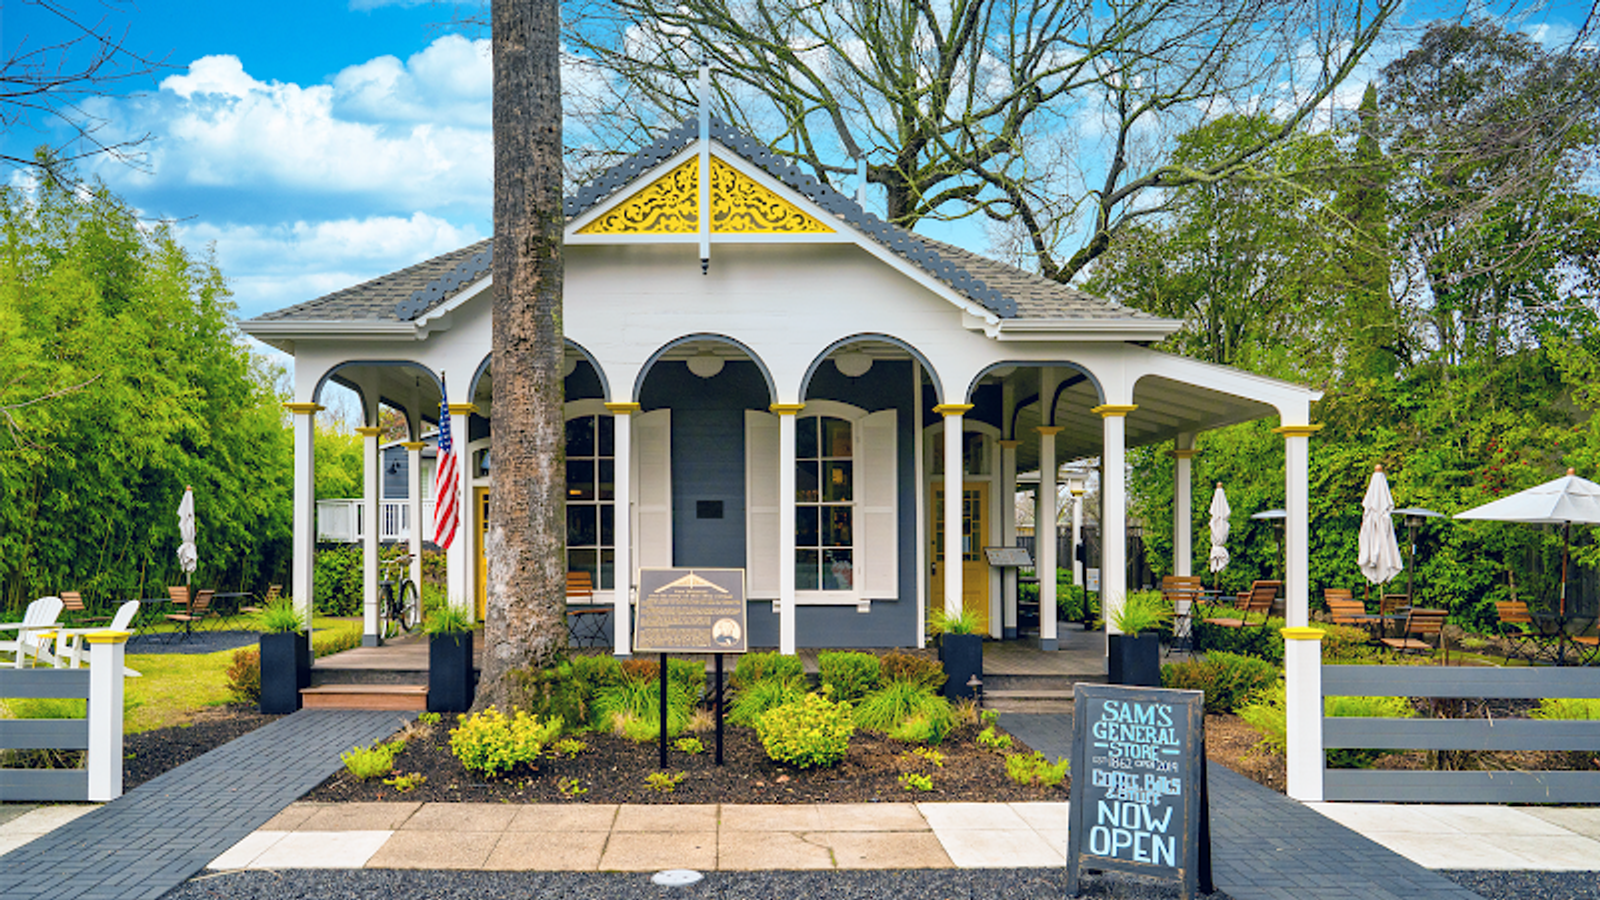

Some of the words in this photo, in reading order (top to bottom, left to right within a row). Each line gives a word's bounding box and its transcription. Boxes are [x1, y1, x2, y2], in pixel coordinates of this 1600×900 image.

[1101, 700, 1173, 728] SAM'S
[1092, 721, 1180, 746] GENERAL
[1108, 742, 1160, 761] STORE
[1097, 800, 1173, 833] NOW
[1090, 825, 1176, 868] OPEN
